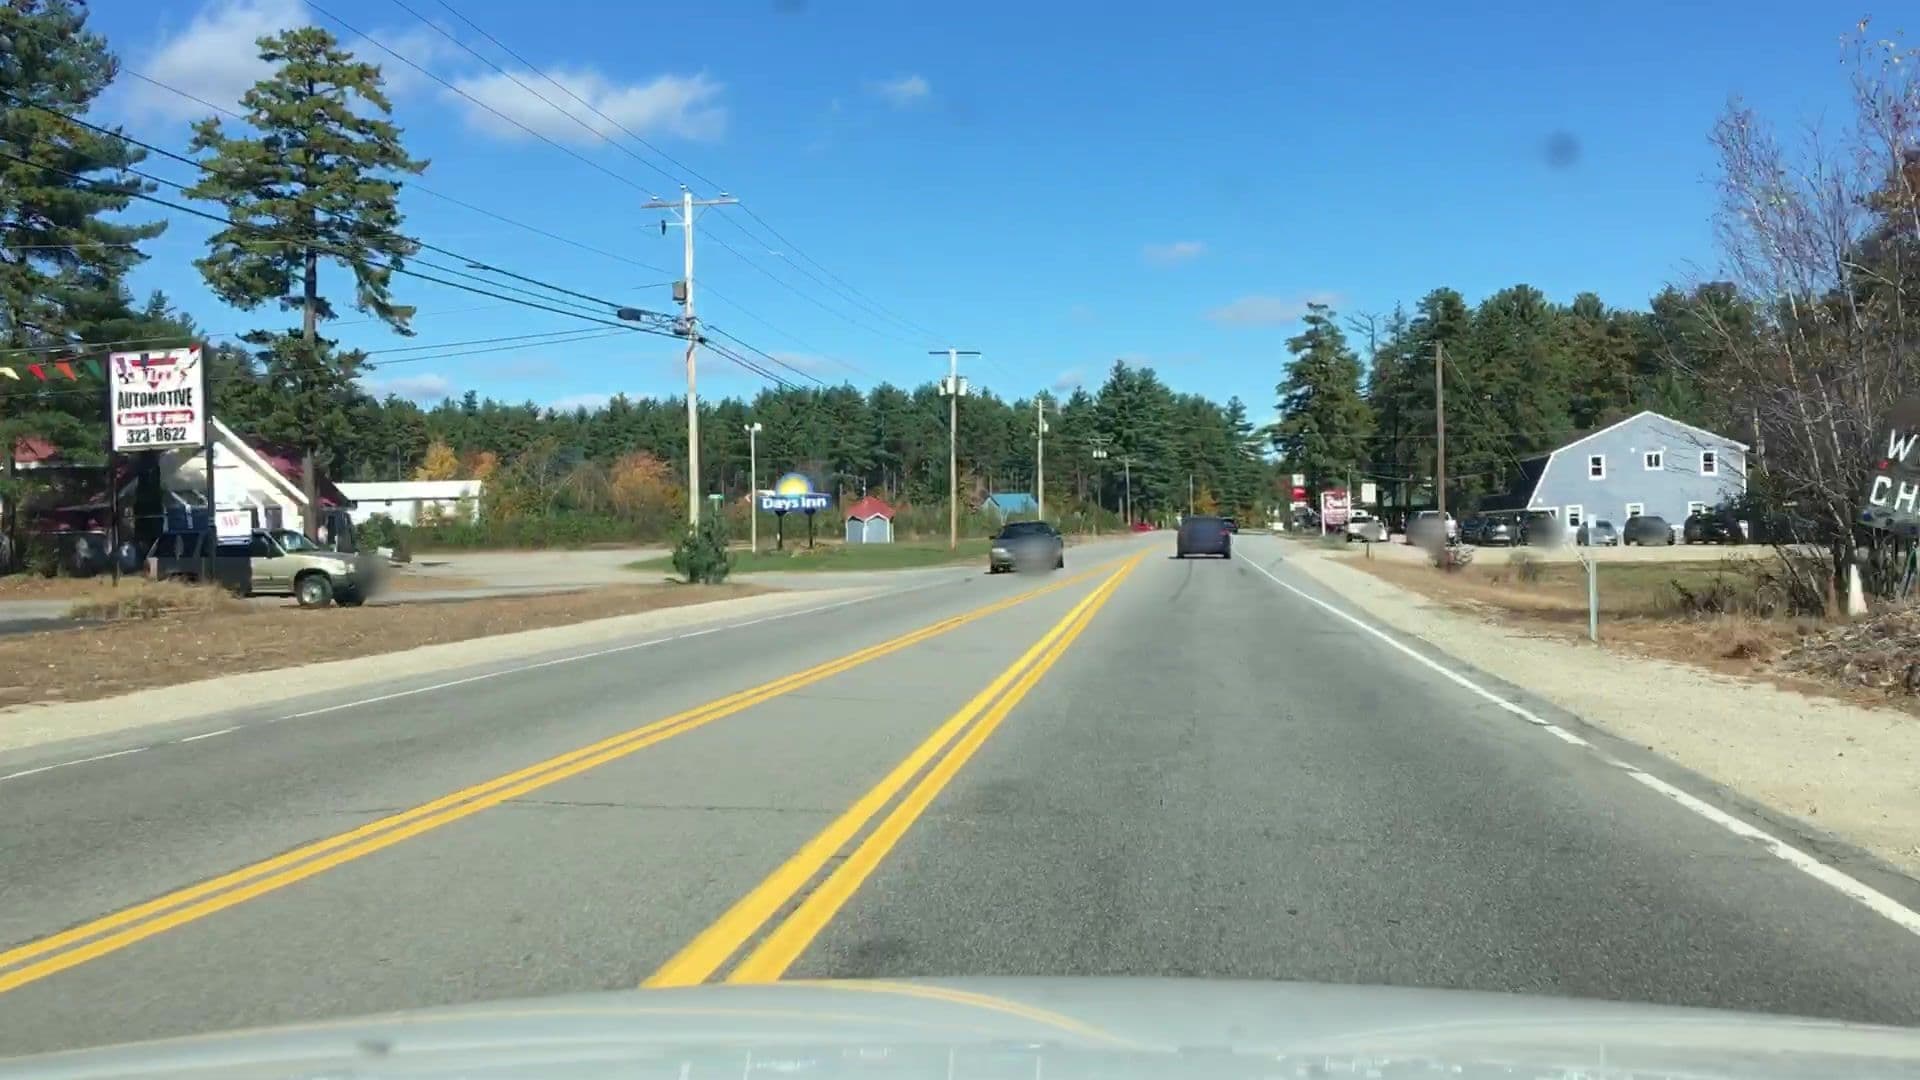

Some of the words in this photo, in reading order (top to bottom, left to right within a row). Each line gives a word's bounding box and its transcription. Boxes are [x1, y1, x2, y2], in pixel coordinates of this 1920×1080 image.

[118, 387, 193, 411] AUTOMOTIVE
[126, 427, 187, 443] 323-8622
[762, 497, 799, 510] Days
[801, 497, 827, 508] Inn
[1869, 475, 1920, 514] CH
